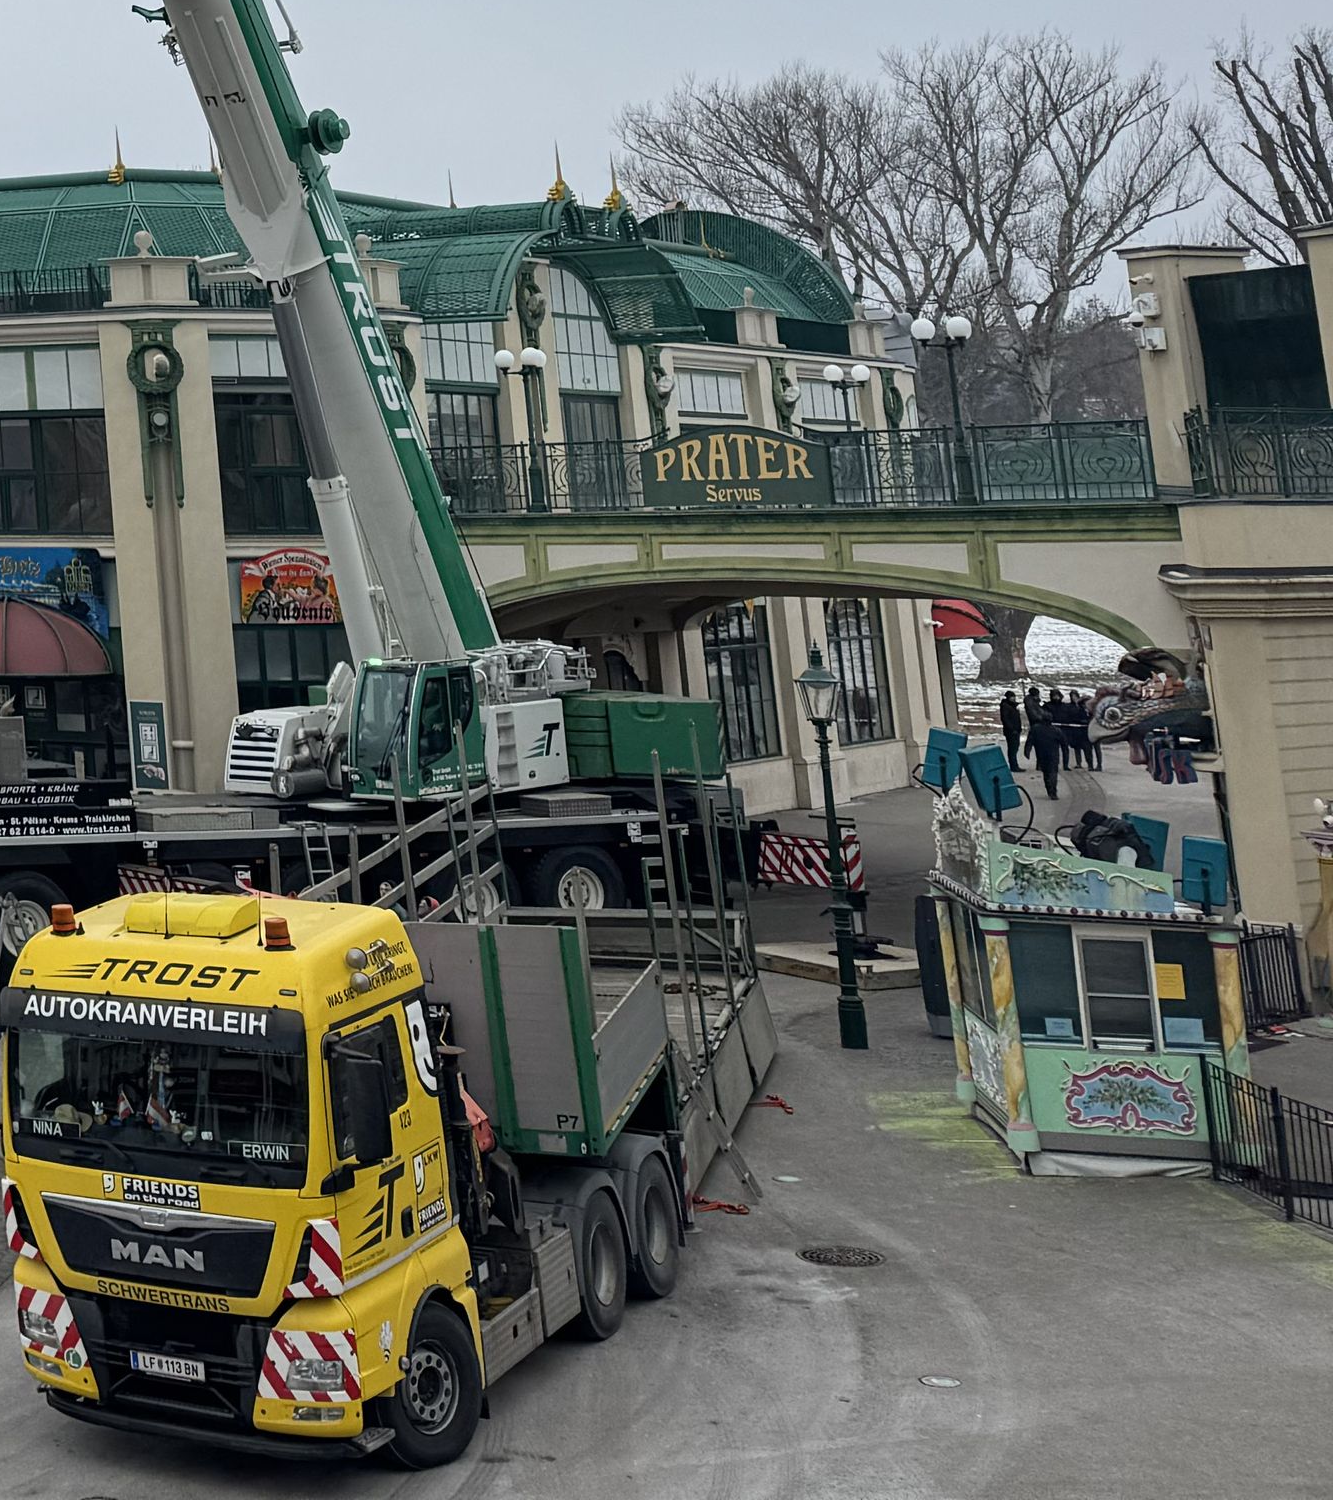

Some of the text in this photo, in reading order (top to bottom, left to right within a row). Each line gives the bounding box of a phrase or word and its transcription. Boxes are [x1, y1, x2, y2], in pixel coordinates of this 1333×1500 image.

[333, 239, 427, 452] TROST
[653, 432, 814, 482] PRATER
[705, 484, 762, 502] Servus
[101, 958, 262, 991] TROST
[325, 991, 343, 1008] WAS
[24, 994, 267, 1037] AUTOKRANVERLEIH
[33, 1120, 63, 1137] NINA
[242, 1143, 290, 1161] ERWIN
[122, 1177, 199, 1199] FRIENDS
[124, 1192, 200, 1209] on the road
[418, 1198, 446, 1224] FRIENDS
[111, 1238, 205, 1272] MAN
[97, 1279, 230, 1312] SCHWERTRANS
[142, 1355, 199, 1377] LF 113 BN
